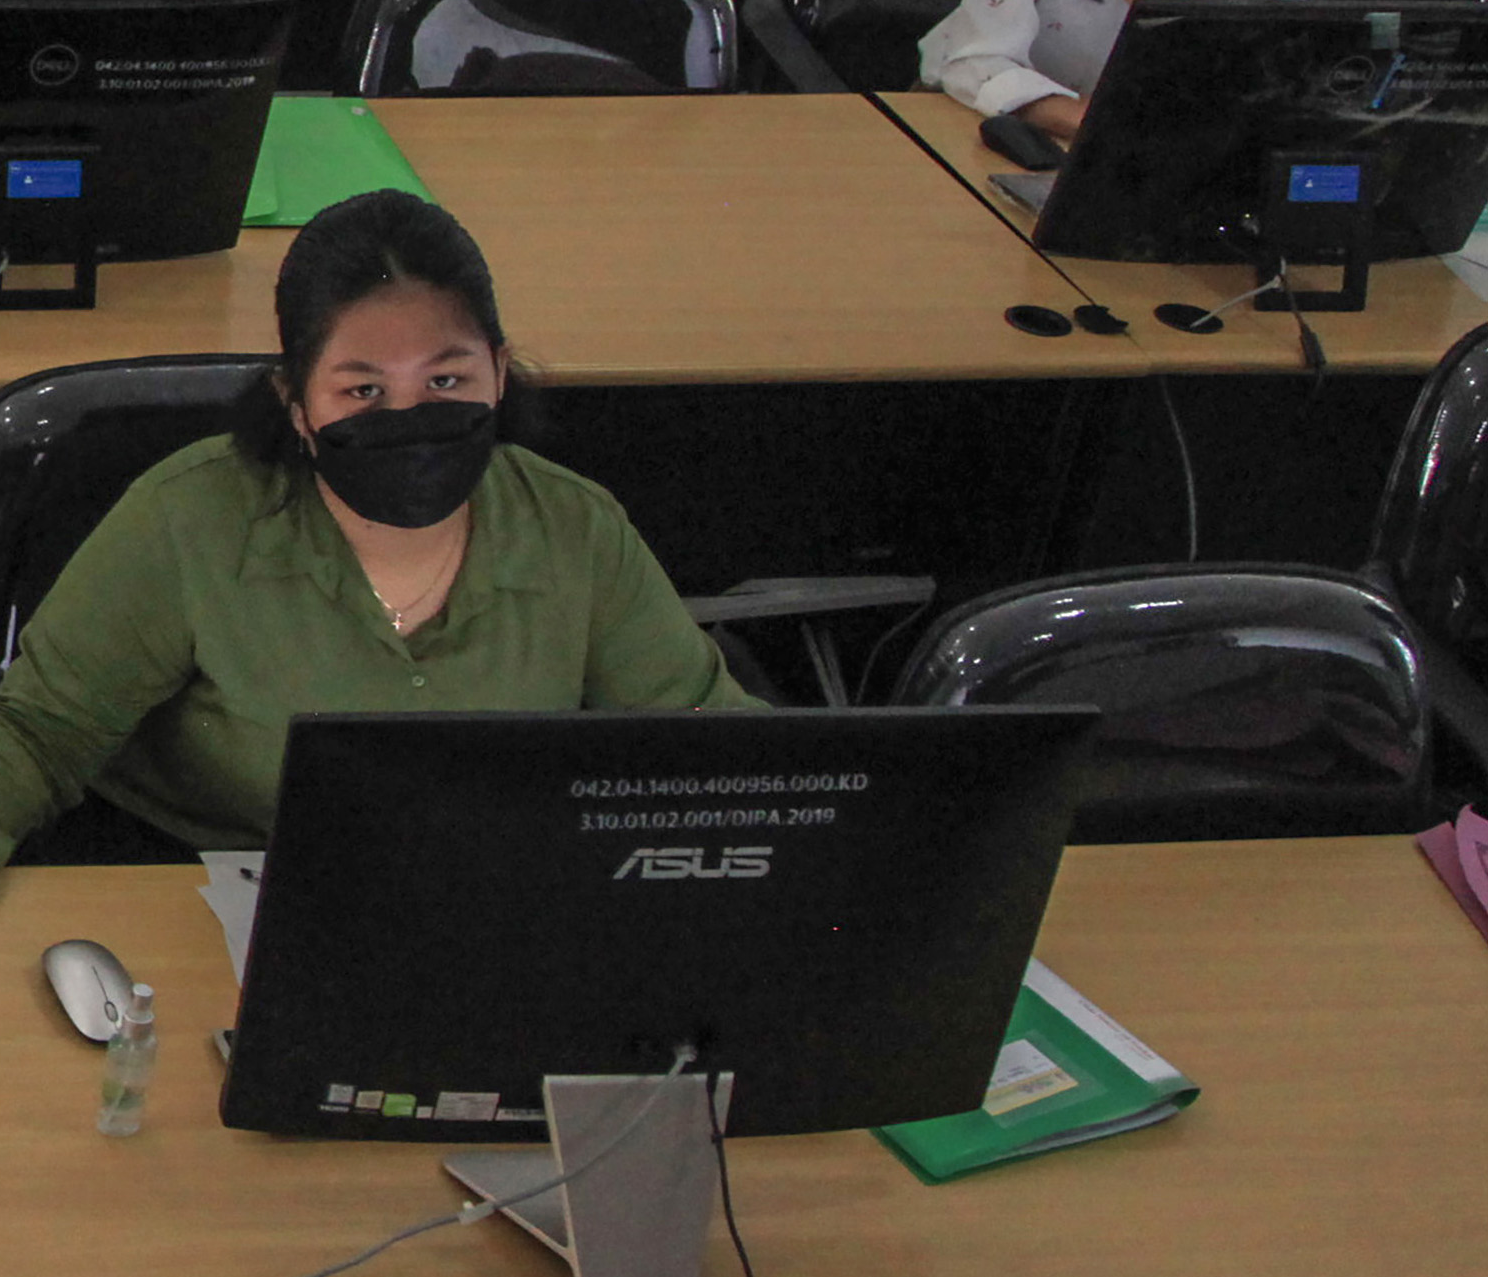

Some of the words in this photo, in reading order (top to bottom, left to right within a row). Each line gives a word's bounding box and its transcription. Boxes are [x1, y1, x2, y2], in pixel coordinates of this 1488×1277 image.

[571, 772, 868, 798] 042.04.1400.400956.000.KD
[580, 807, 836, 831] 3.10.01.02.001/DIPA.2019
[612, 845, 774, 880] ASUS
